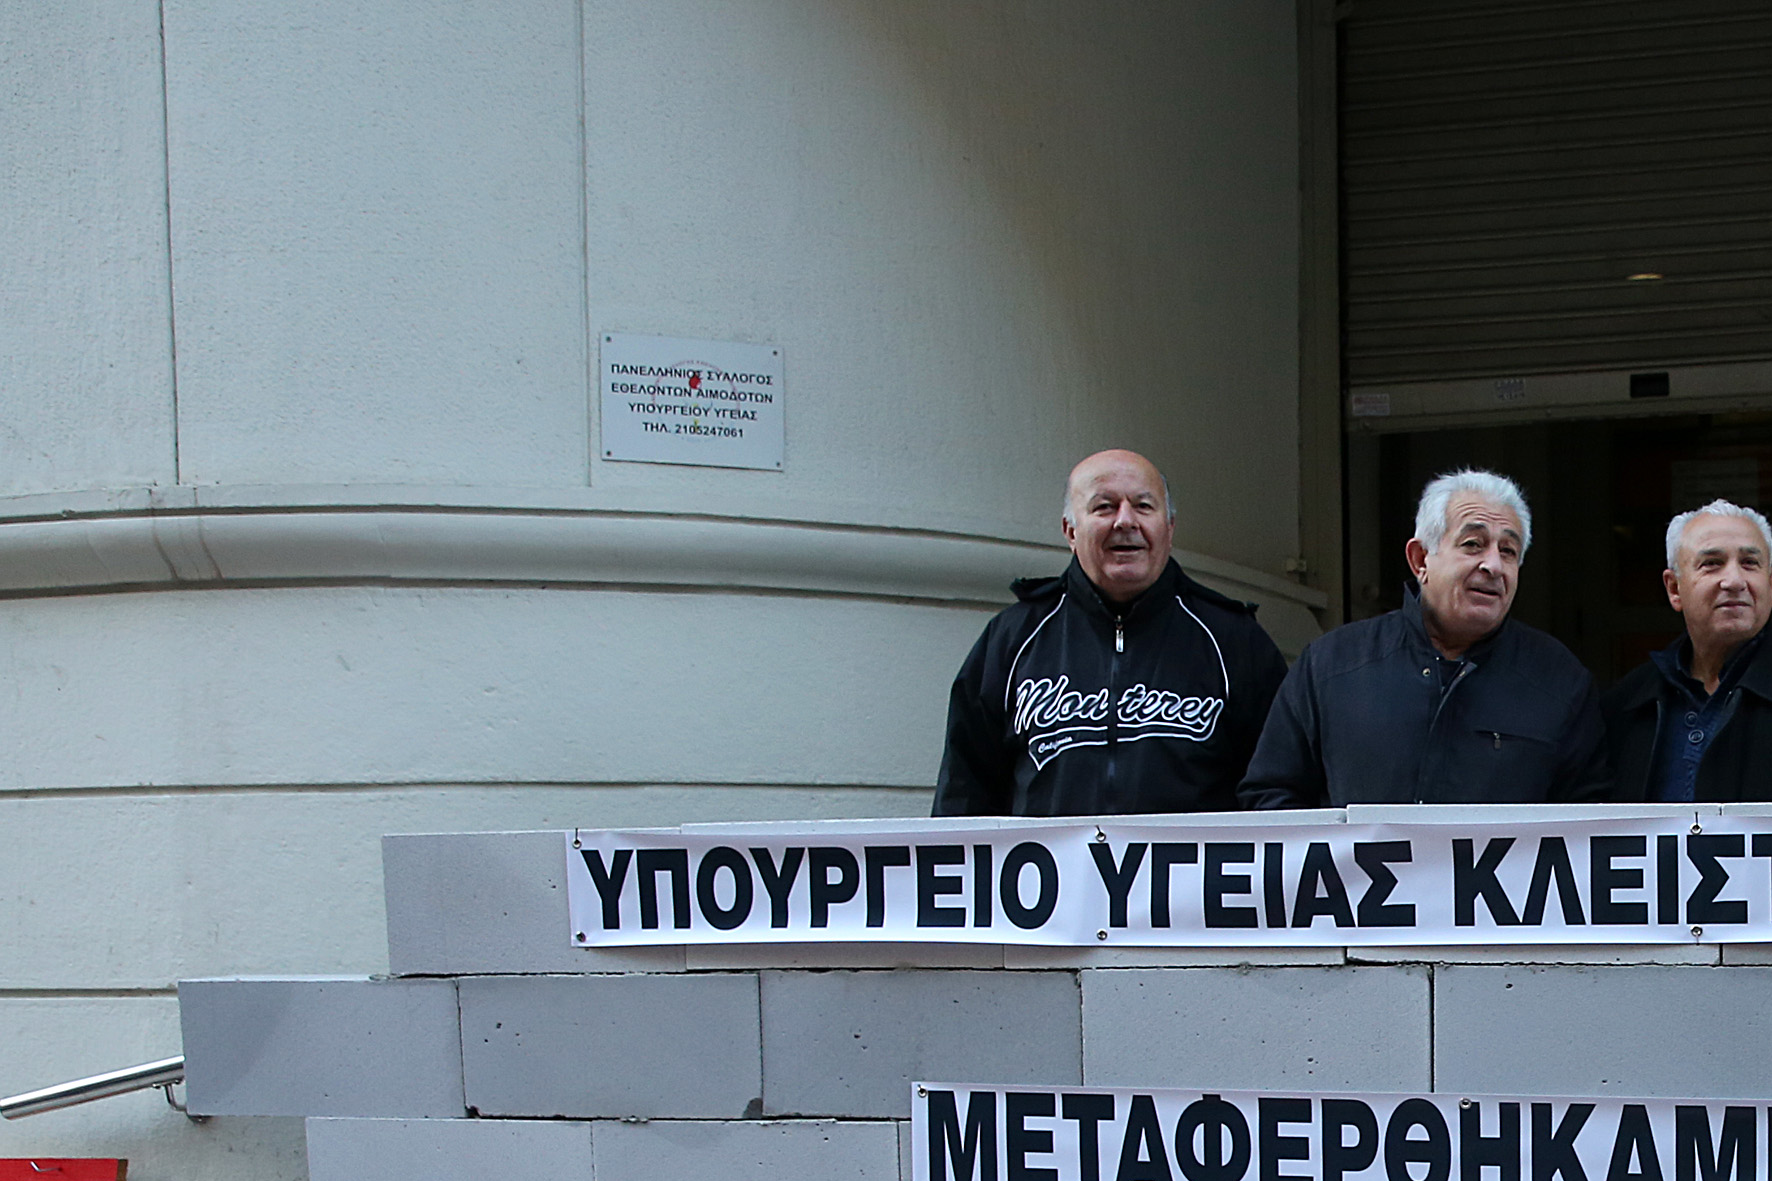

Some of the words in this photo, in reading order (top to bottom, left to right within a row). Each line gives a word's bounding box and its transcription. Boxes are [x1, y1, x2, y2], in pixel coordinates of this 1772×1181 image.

[611, 363, 703, 380] ΠΑΝΕΛΛΗΝΙΟΣ
[707, 370, 773, 386] ΣΥΛΛΟΓΟΣ
[611, 382, 692, 398] ΕΘΕΛΟΝΤΩΝ
[696, 388, 773, 403] ΑΙΜΟΔΟΤΩΝ
[628, 402, 711, 417] ΥΠΟΥΡΓΕΙΟΥ
[714, 408, 758, 421] ΥΓΕΙΑΣ
[642, 421, 671, 433] ΤΗΛ.
[675, 423, 744, 438] 2105247061
[580, 841, 1059, 931] ΥΠΟΥΡΓΕΙΟ
[1087, 840, 1417, 929] ΥΓΕΙΑΣ
